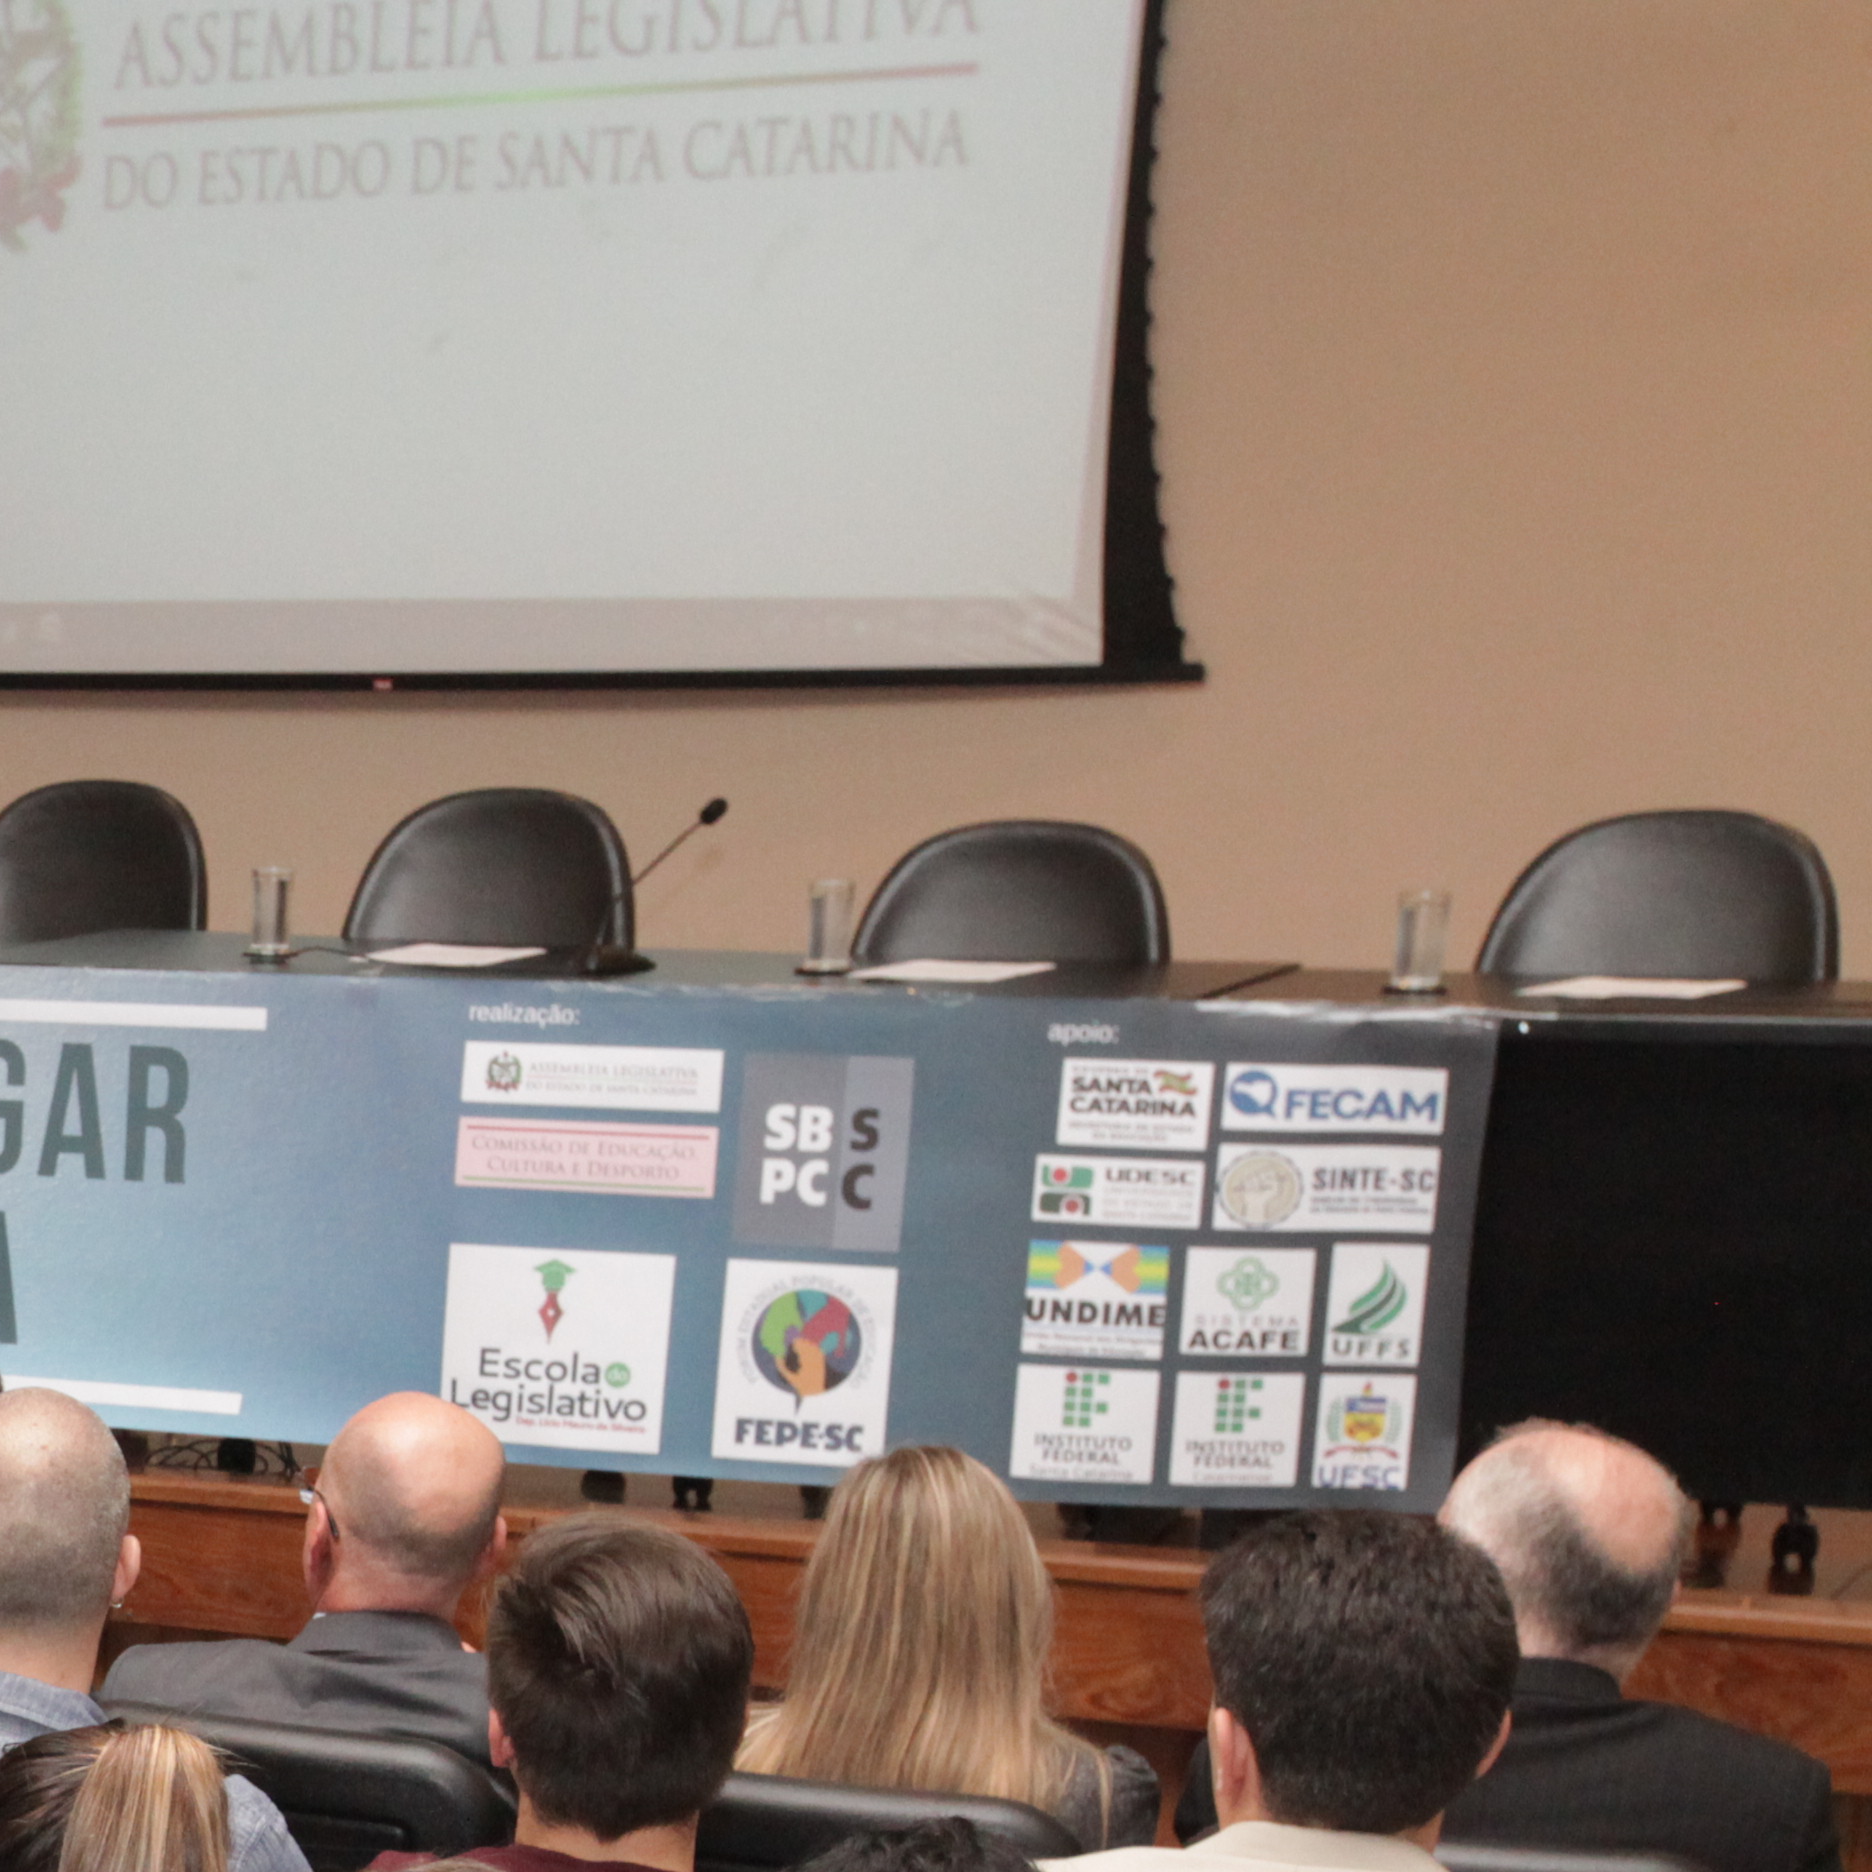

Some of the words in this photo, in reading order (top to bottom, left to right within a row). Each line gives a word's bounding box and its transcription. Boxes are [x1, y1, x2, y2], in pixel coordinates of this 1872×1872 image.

[113, 0, 506, 90] ASSEMBLEIA
[104, 151, 179, 211] DO
[198, 140, 390, 205] ESTADO
[411, 133, 481, 195] DE
[495, 124, 666, 190] SANTA
[682, 107, 970, 180] CATARINA
[468, 1003, 581, 1029] realização:
[1048, 1021, 1120, 1046] apoio:
[1071, 1076, 1153, 1095] SANTA
[1069, 1097, 1197, 1119] CATARINA
[1284, 1088, 1441, 1122] FECAM
[471, 1132, 563, 1152] COMISSÃO
[568, 1140, 592, 1155] DE
[486, 1155, 567, 1175] CULTURA
[587, 1160, 681, 1181] DESPORTO
[1106, 1166, 1196, 1186] UDESC
[1312, 1165, 1436, 1193] SINTE-SC
[1025, 1297, 1167, 1328] UNDIME
[1188, 1330, 1301, 1351] ACAFE
[1332, 1336, 1411, 1359] UFFS
[479, 1347, 601, 1385] Escola
[451, 1378, 648, 1422] Legislativo
[1034, 1432, 1133, 1452] INSTITUTO
[1185, 1439, 1286, 1457] INSTITUTO
[1041, 1447, 1120, 1466] FEDERAL
[1193, 1453, 1273, 1470] FEDERAL
[1318, 1465, 1401, 1491] UFSC
